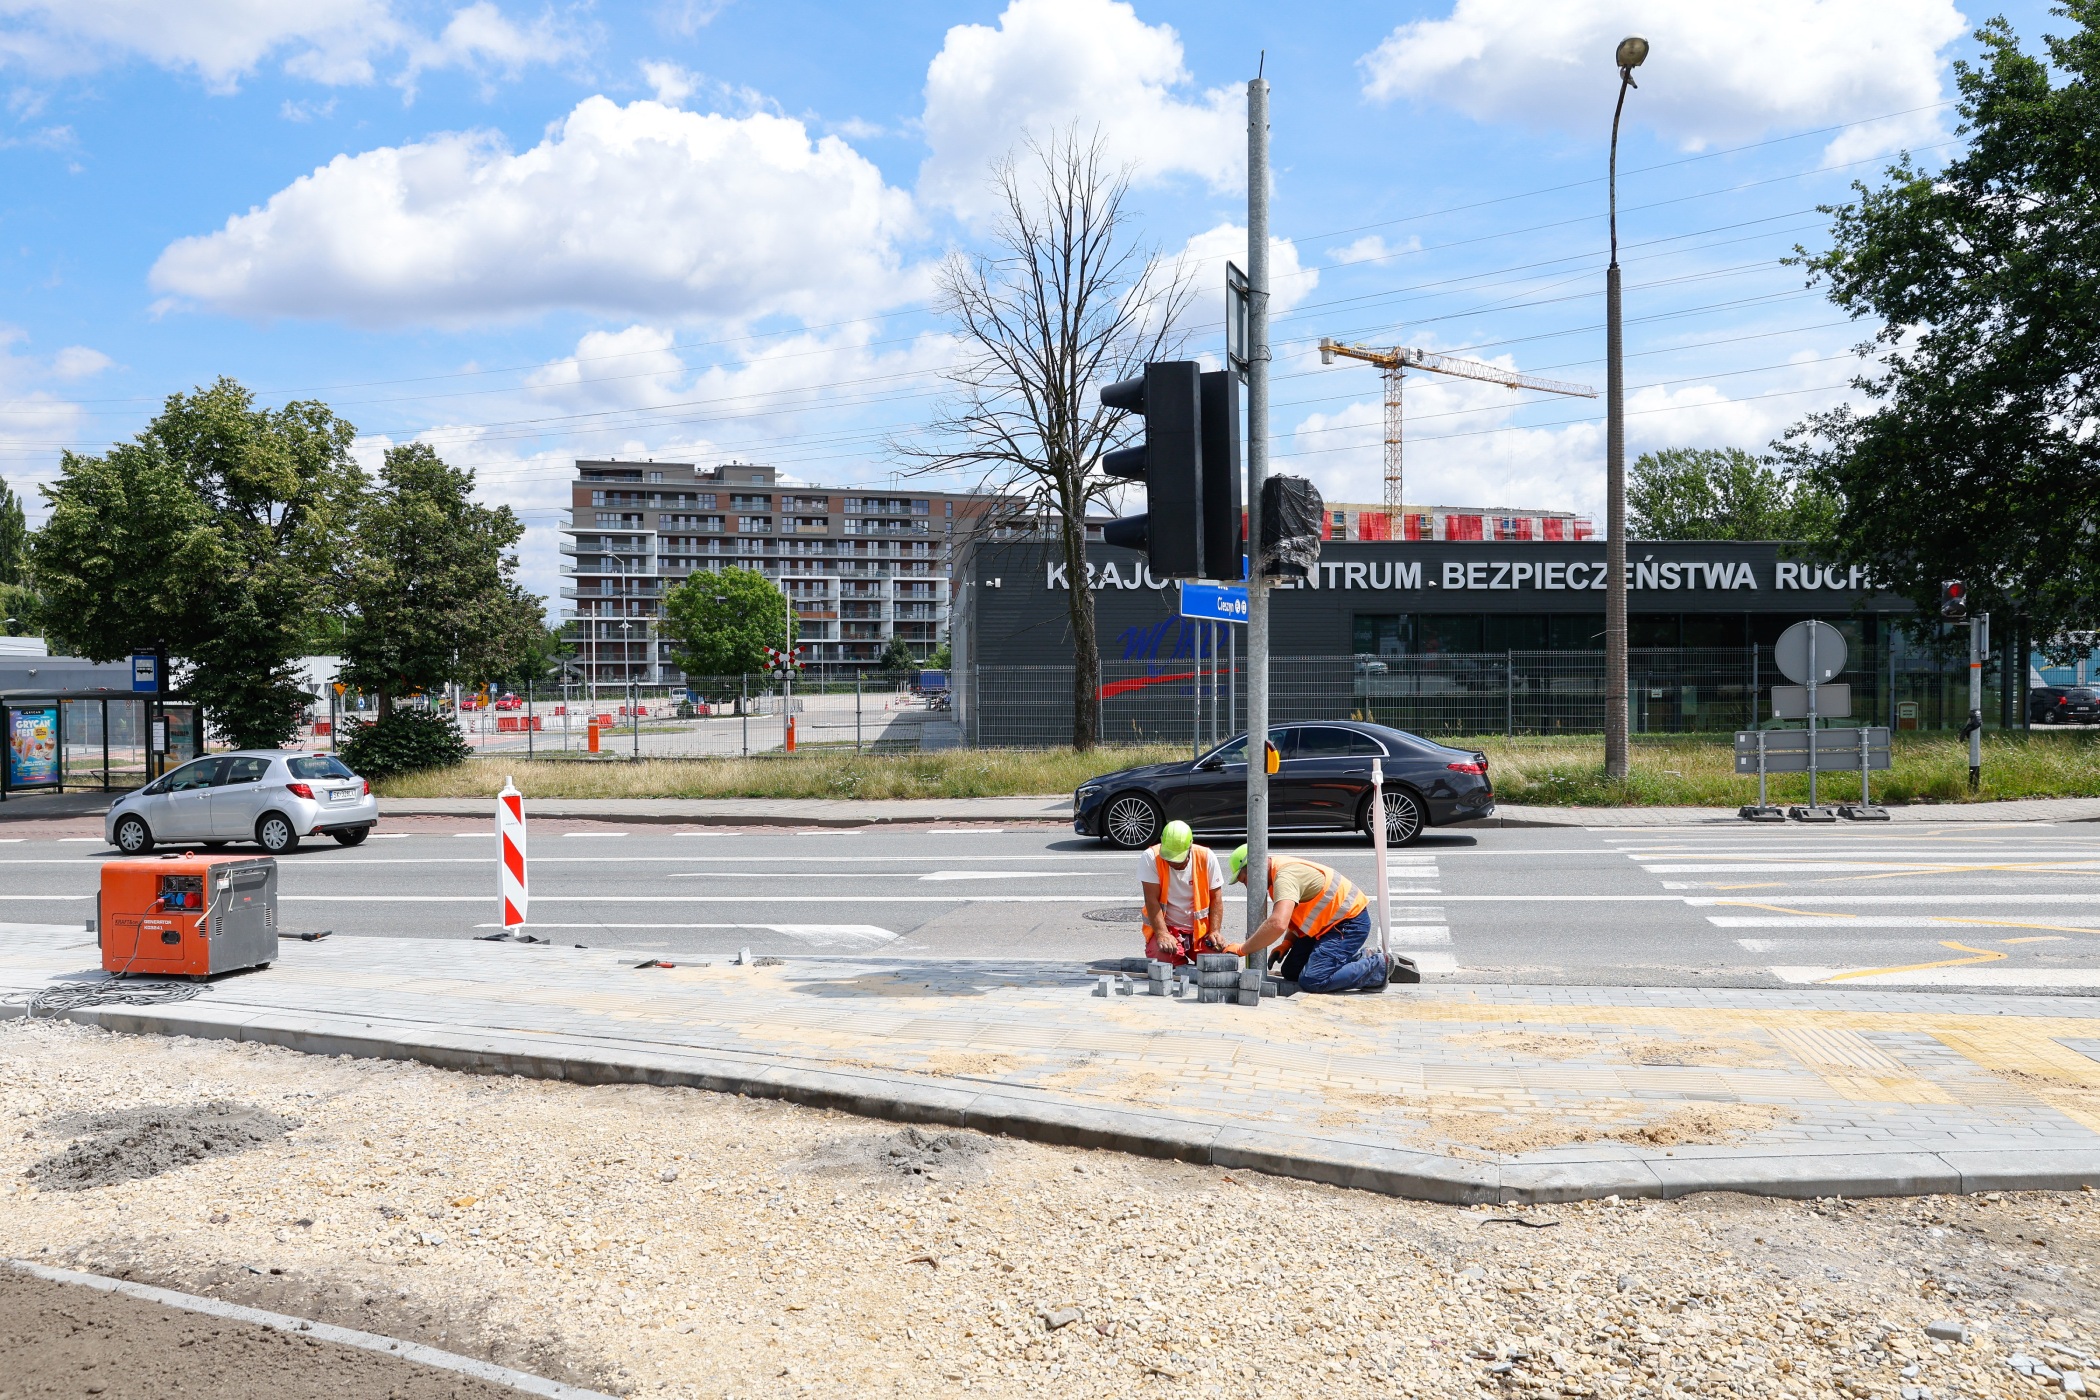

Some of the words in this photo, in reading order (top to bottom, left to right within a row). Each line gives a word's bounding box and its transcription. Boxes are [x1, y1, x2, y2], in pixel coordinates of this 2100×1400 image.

[1775, 562, 1887, 590] RUCH
[15, 720, 51, 728] GRYCAN
[16, 728, 34, 737] FEST
